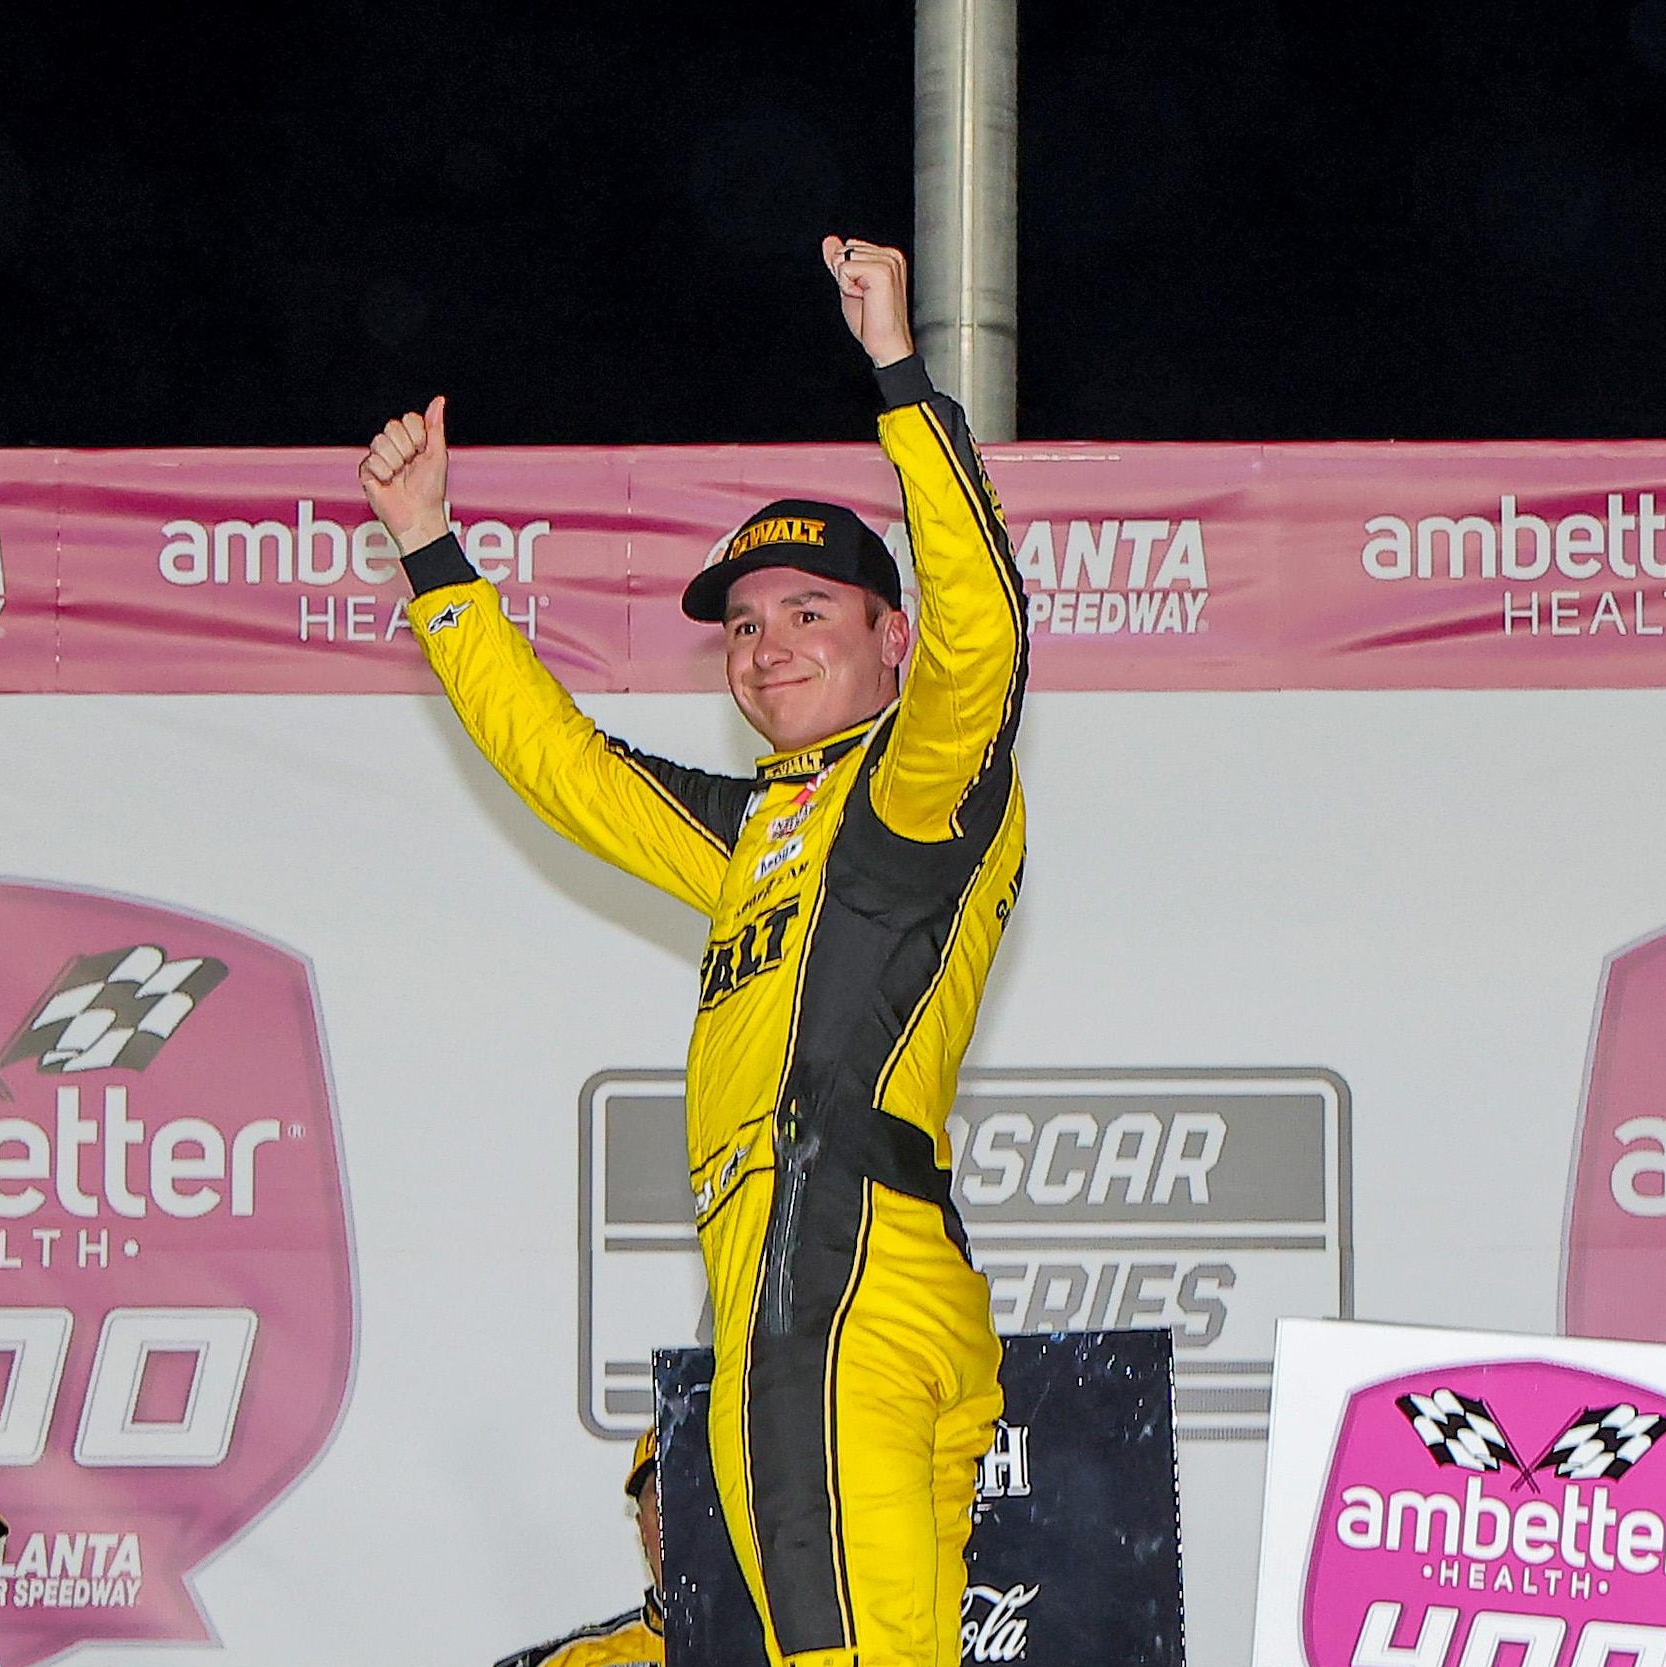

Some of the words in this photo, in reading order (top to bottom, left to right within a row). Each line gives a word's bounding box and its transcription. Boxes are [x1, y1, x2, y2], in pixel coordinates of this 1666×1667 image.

[159, 500, 552, 586] ambeer
[1026, 591, 1210, 635] PEEDWAY
[948, 1112, 1228, 1206] SCAR
[983, 1264, 1237, 1348] ERIES
[12, 1576, 143, 1608] SPEEDWAY
[1439, 1562, 1593, 1600] HEALTH
